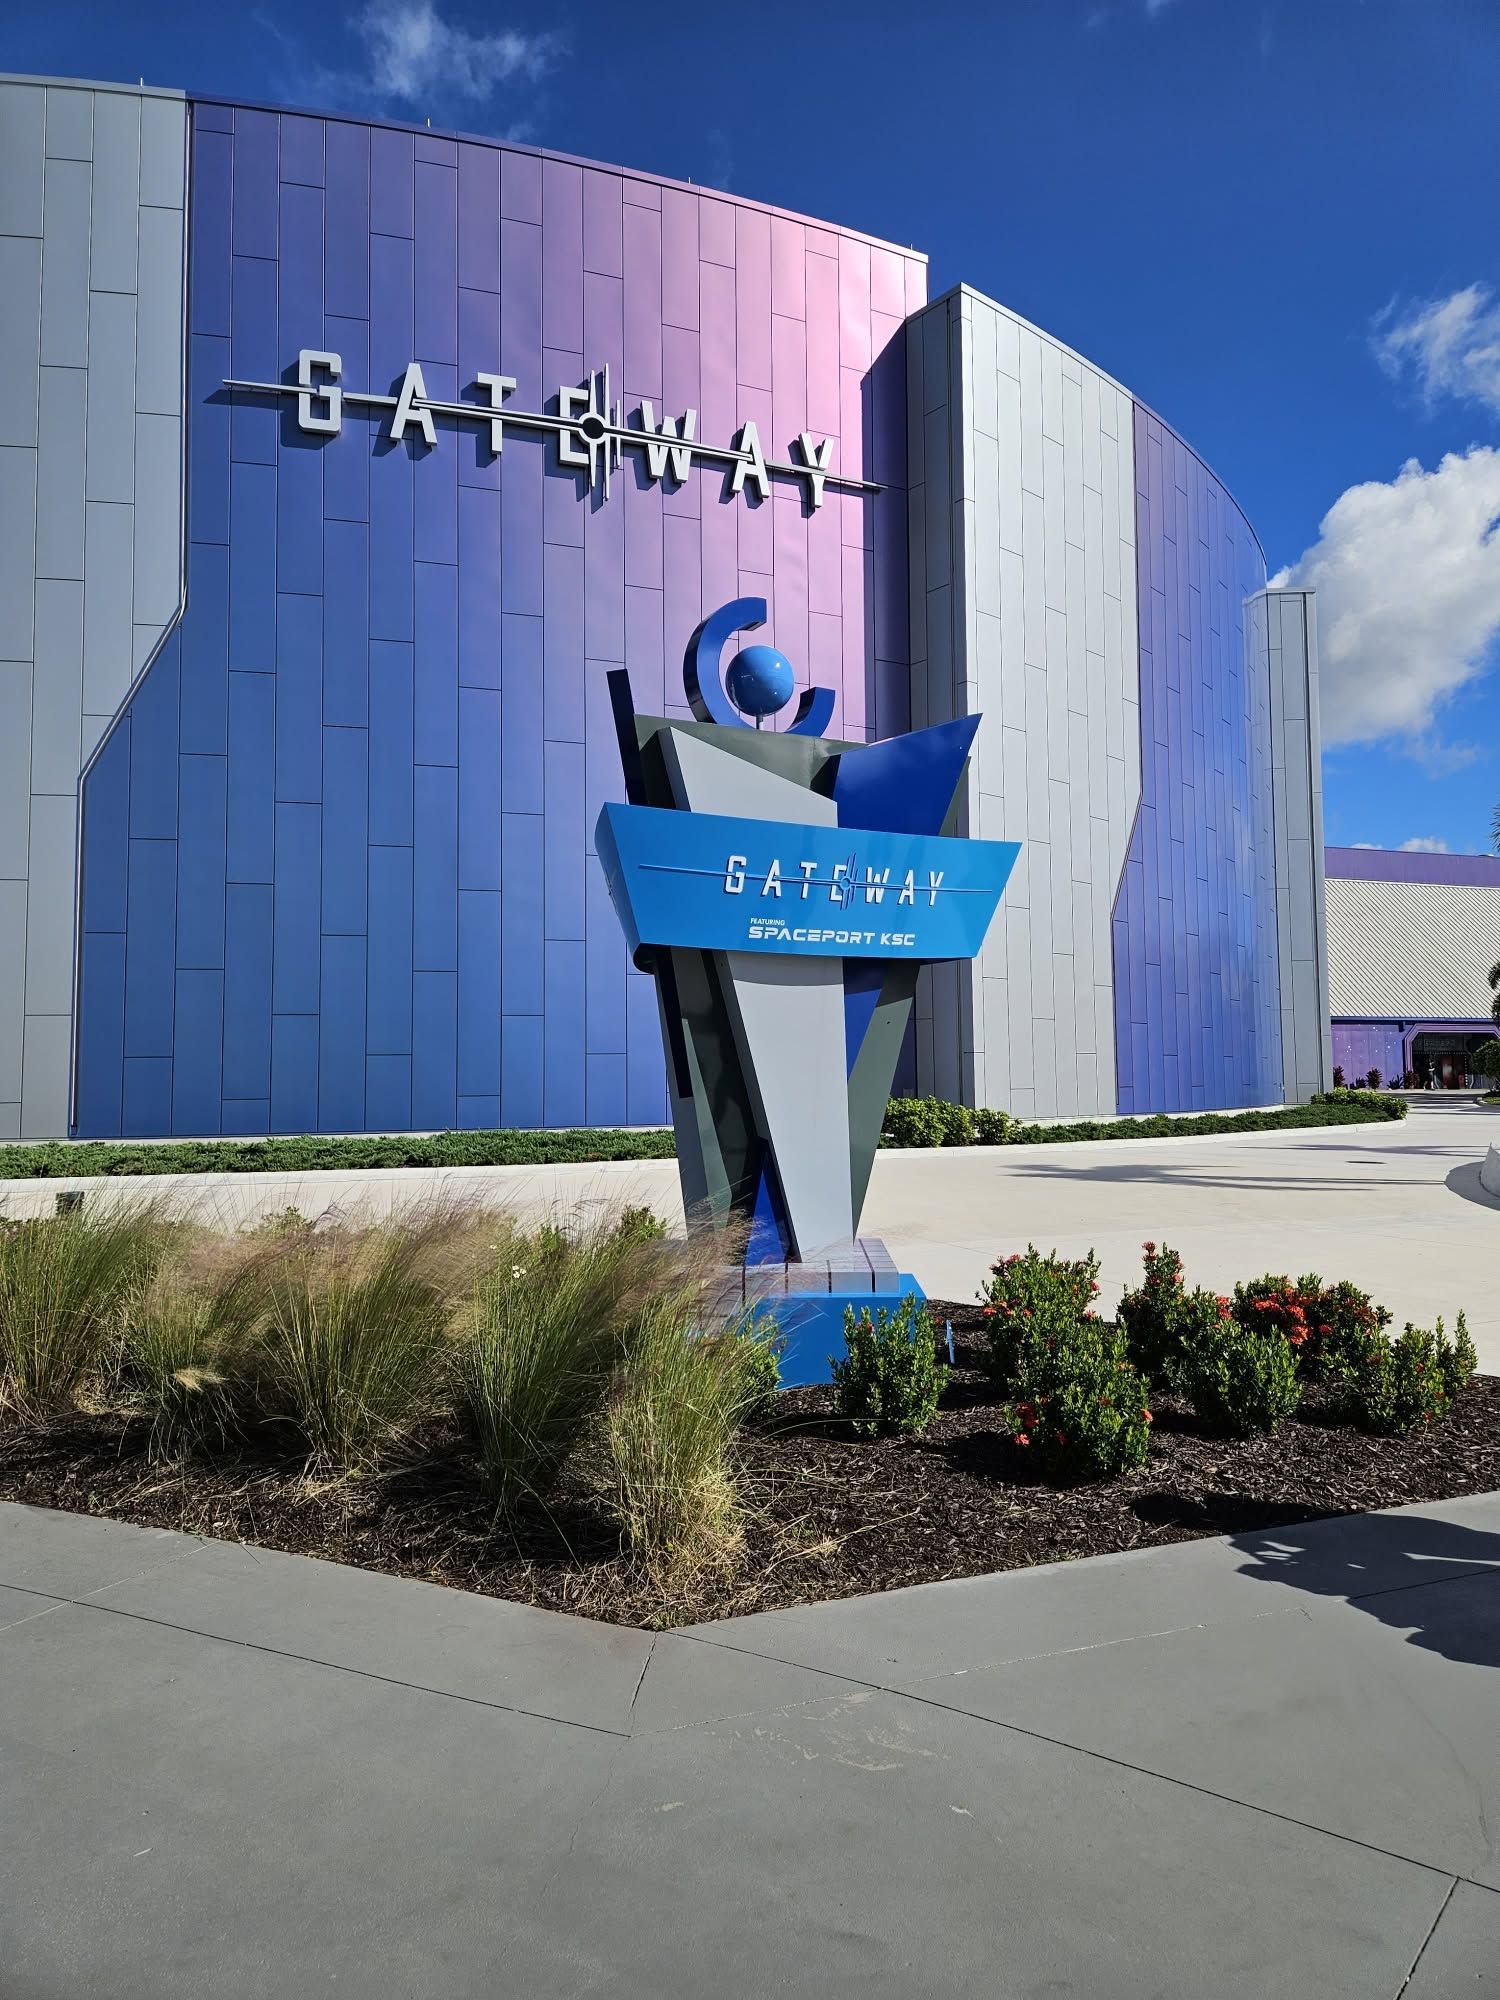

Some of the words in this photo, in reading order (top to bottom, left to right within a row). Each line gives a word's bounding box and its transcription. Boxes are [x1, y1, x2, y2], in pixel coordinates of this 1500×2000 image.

[298, 349, 835, 508] GATEWAY
[724, 854, 945, 906] GATEWAY
[748, 925, 876, 945] SPACEPORT
[879, 932, 916, 946] KSC
[750, 917, 786, 926] FEATURING
